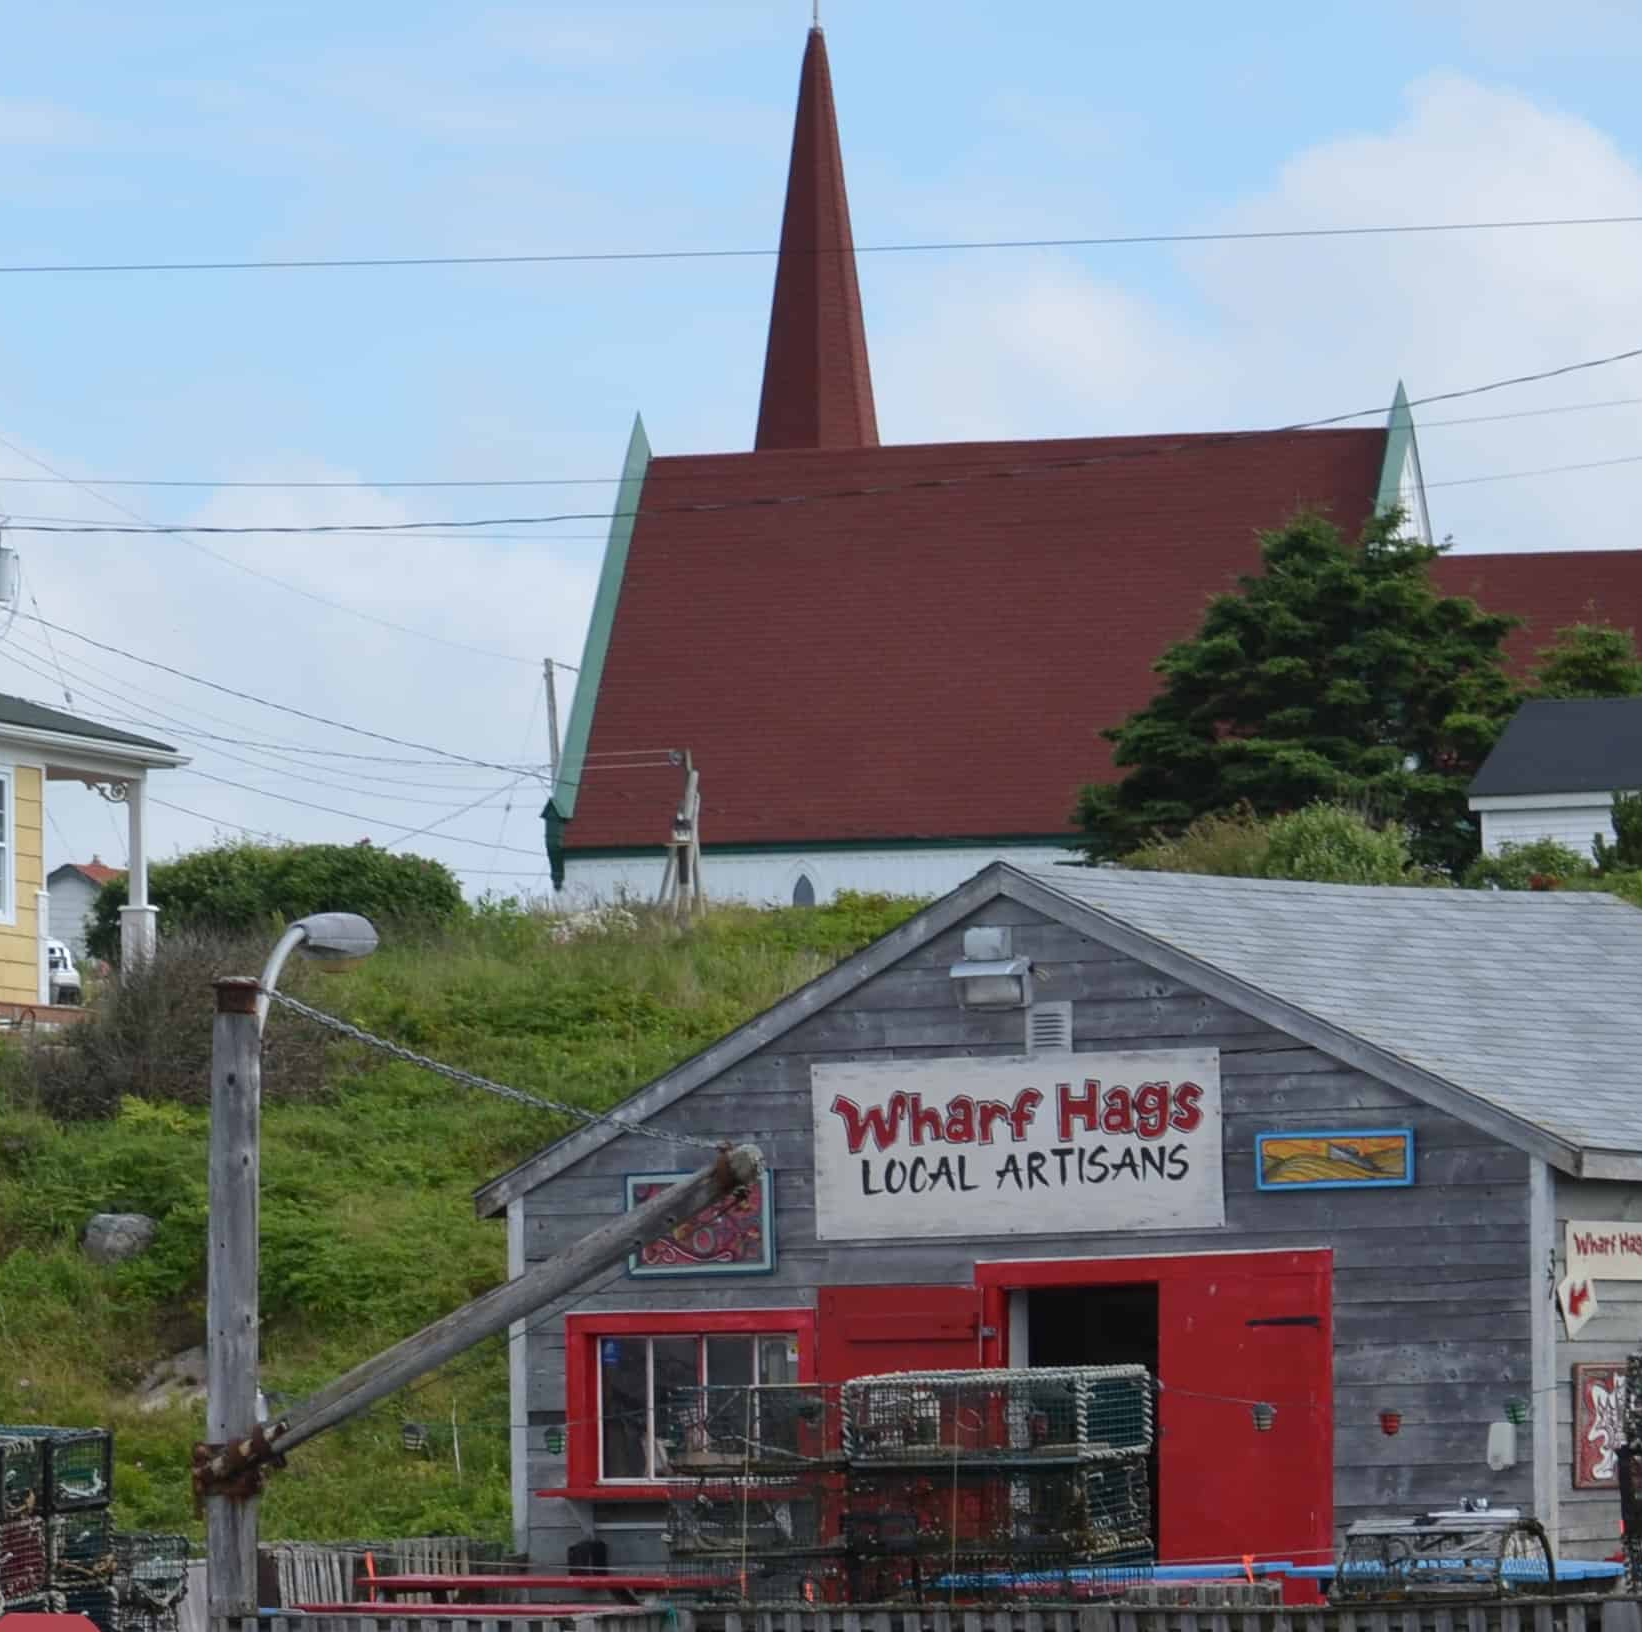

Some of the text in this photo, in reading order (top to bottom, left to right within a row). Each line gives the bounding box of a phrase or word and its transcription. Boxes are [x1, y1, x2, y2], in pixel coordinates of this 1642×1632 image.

[830, 1078, 1205, 1154] Wharf Hags
[861, 1143, 1190, 1196] LOCAL ARTISANS
[1573, 1231, 1617, 1256] Wharf
